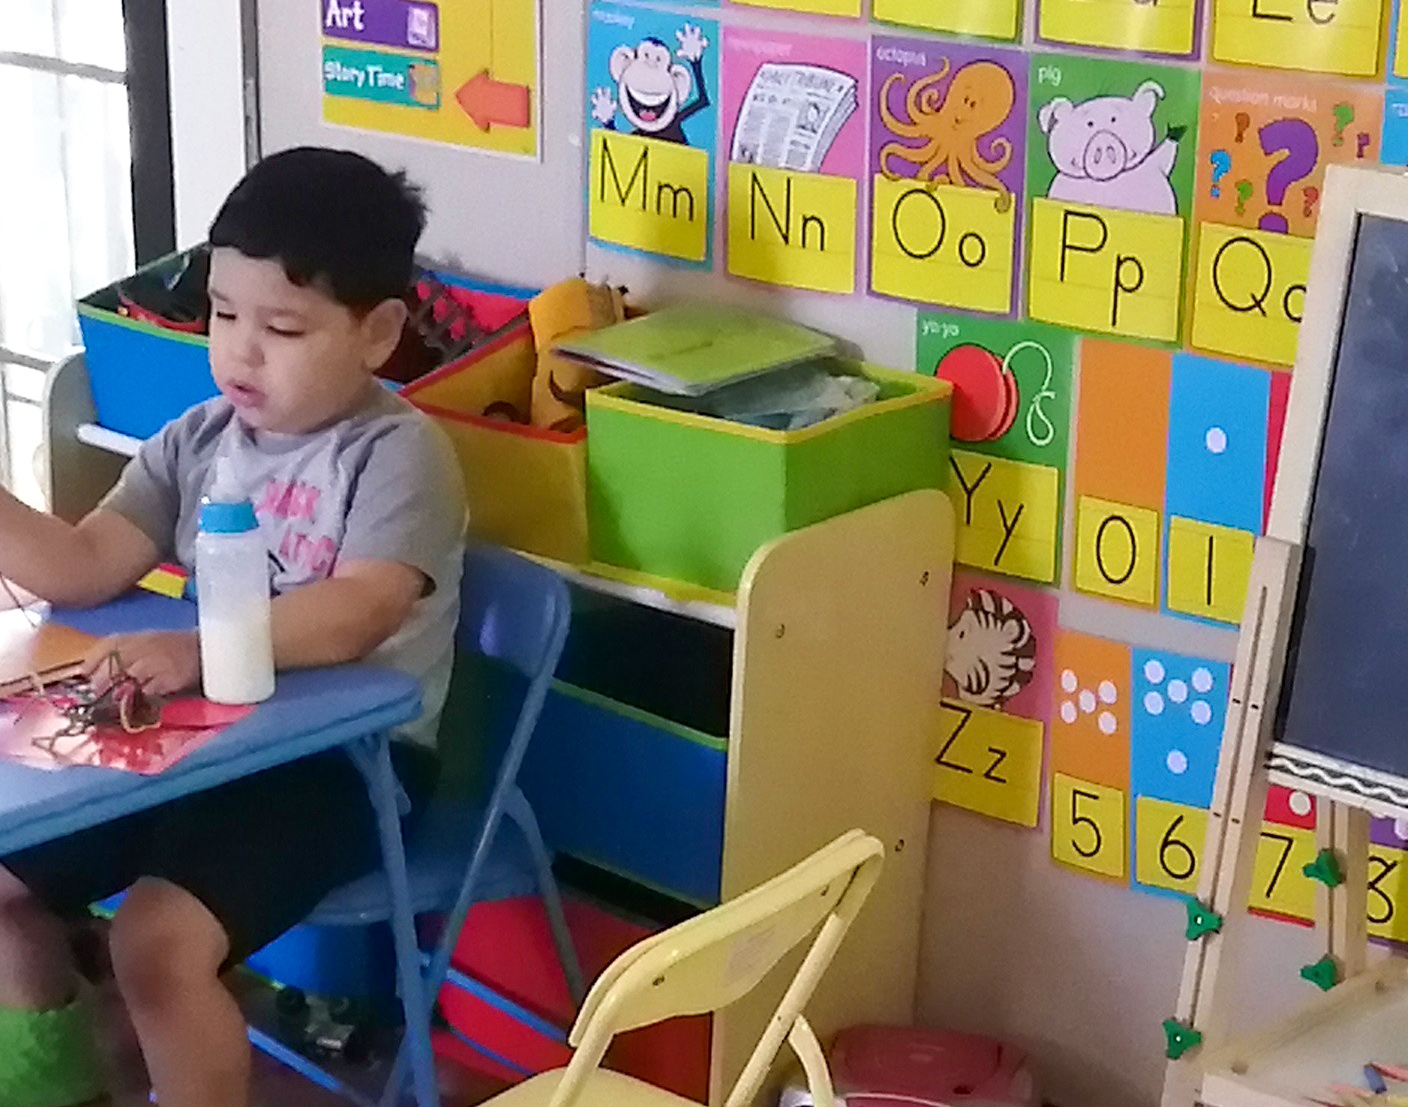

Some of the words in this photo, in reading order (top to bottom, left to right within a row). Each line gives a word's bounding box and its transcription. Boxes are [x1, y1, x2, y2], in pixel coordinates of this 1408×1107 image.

[325, 1, 365, 31] Art
[367, 65, 405, 90] Time
[876, 46, 927, 68] octopus
[1038, 65, 1062, 86] pig
[598, 136, 695, 222] Mm
[750, 171, 826, 252] Nn
[892, 188, 986, 268] Oo
[1059, 210, 1144, 327] Pp
[921, 317, 960, 338] yo-yo
[949, 455, 1024, 567] Yy
[935, 700, 1008, 785] Zz
[1072, 788, 1103, 857] 5
[1159, 815, 1196, 880] 6
[1260, 831, 1295, 899] 7
[1368, 855, 1399, 924] 8
